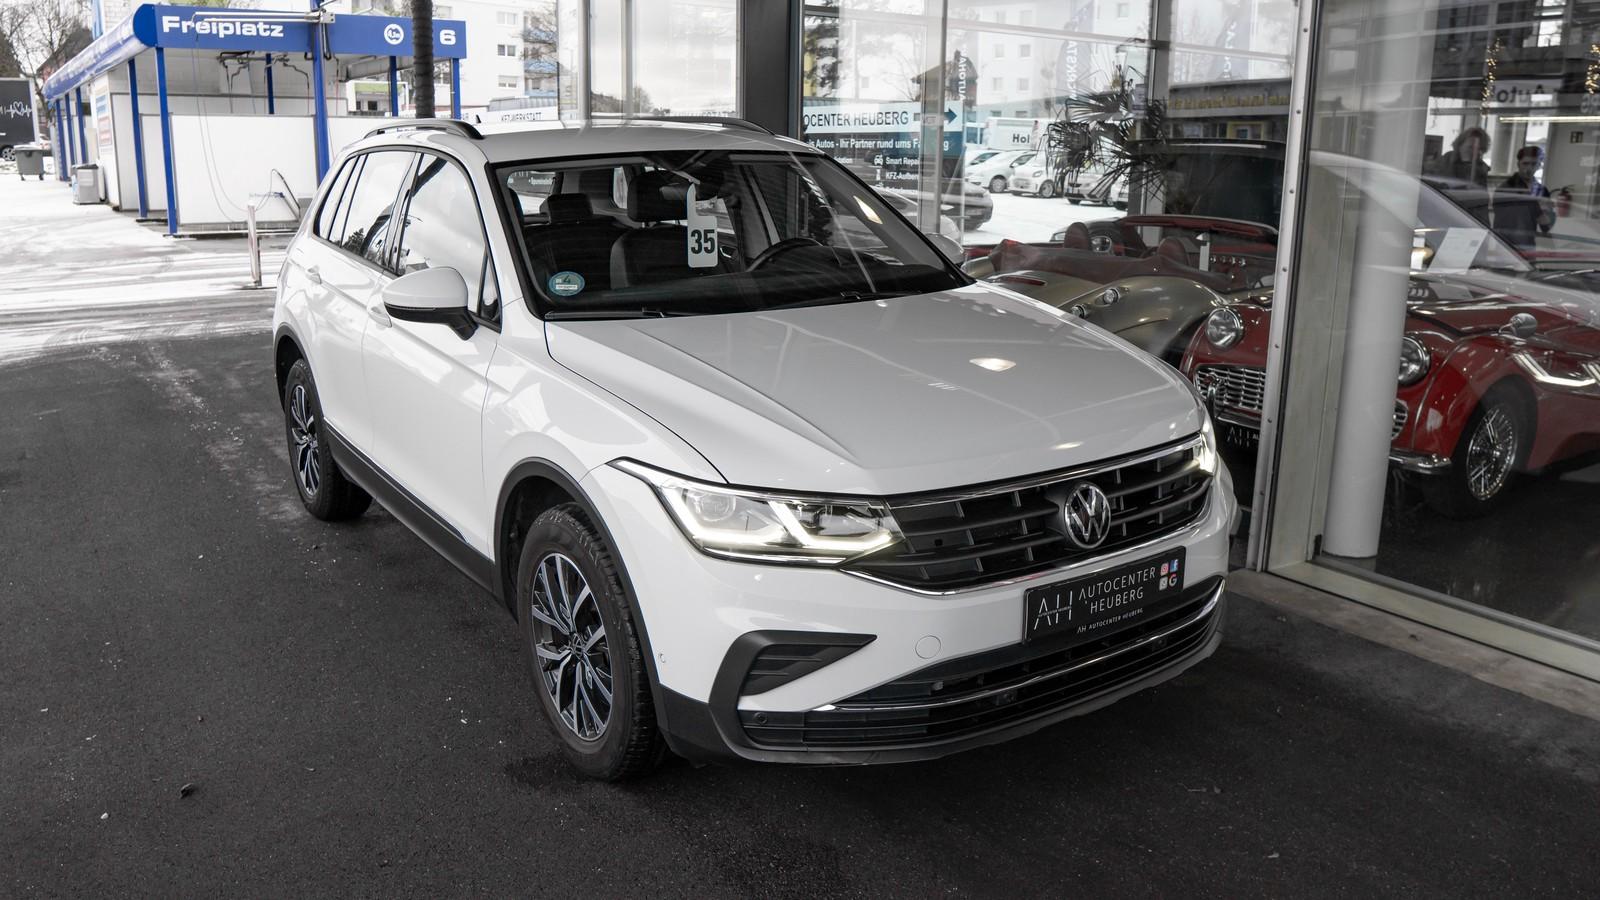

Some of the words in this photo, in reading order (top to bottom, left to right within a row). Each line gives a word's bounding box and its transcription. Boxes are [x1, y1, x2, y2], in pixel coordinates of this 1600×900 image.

[162, 16, 284, 38] Freiplatz
[440, 29, 456, 45] 6
[853, 111, 909, 126] HEUBERG
[816, 138, 835, 149] Autos
[839, 138, 849, 149] Ihr
[850, 138, 875, 149] Partner
[876, 138, 894, 149] rund
[895, 140, 911, 149] ums
[885, 156, 902, 165] Smart
[690, 228, 716, 255] 35
[563, 274, 571, 284] 4
[1079, 567, 1156, 601] AUTOCENTER
[1033, 590, 1073, 631] AH
[1090, 587, 1144, 615] HEUBERG
[1077, 625, 1087, 634] AH
[1088, 616, 1122, 631] AUTOCENTER
[1122, 607, 1144, 620] HEUBERG
